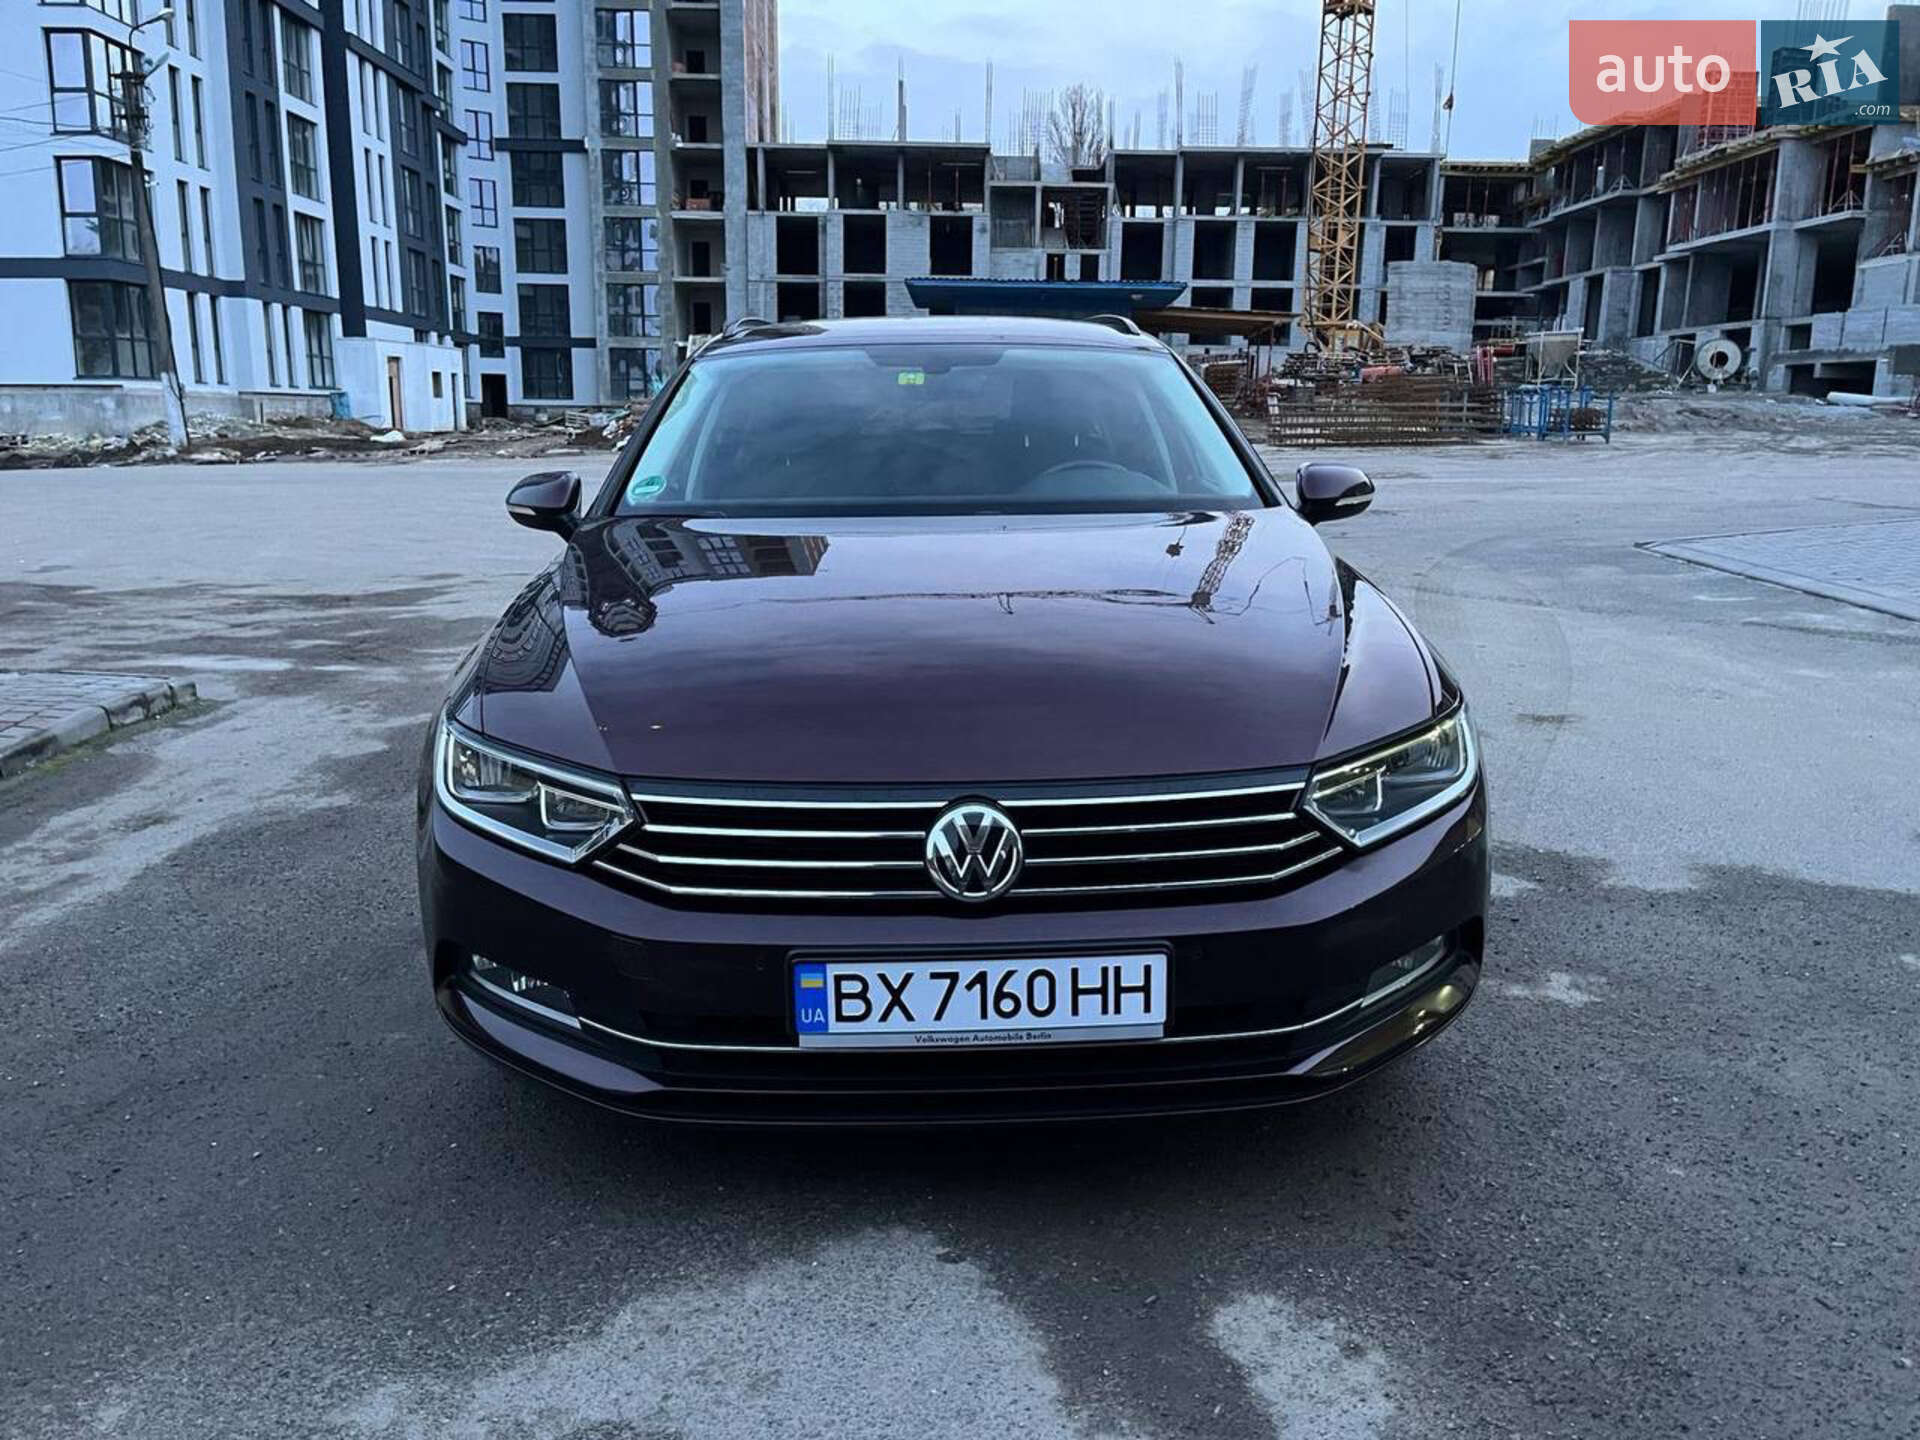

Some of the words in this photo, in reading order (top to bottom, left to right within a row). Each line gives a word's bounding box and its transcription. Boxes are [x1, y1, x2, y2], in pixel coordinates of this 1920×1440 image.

[927, 806, 1022, 900] VW
[833, 972, 916, 1023] BX
[929, 968, 1057, 1021] 7160
[1071, 964, 1152, 1016] HH
[801, 1008, 826, 1023] UA
[914, 1034, 970, 1044] Volkswagen
[972, 1033, 1023, 1042] Automobile
[1026, 1032, 1052, 1040] Berlin
